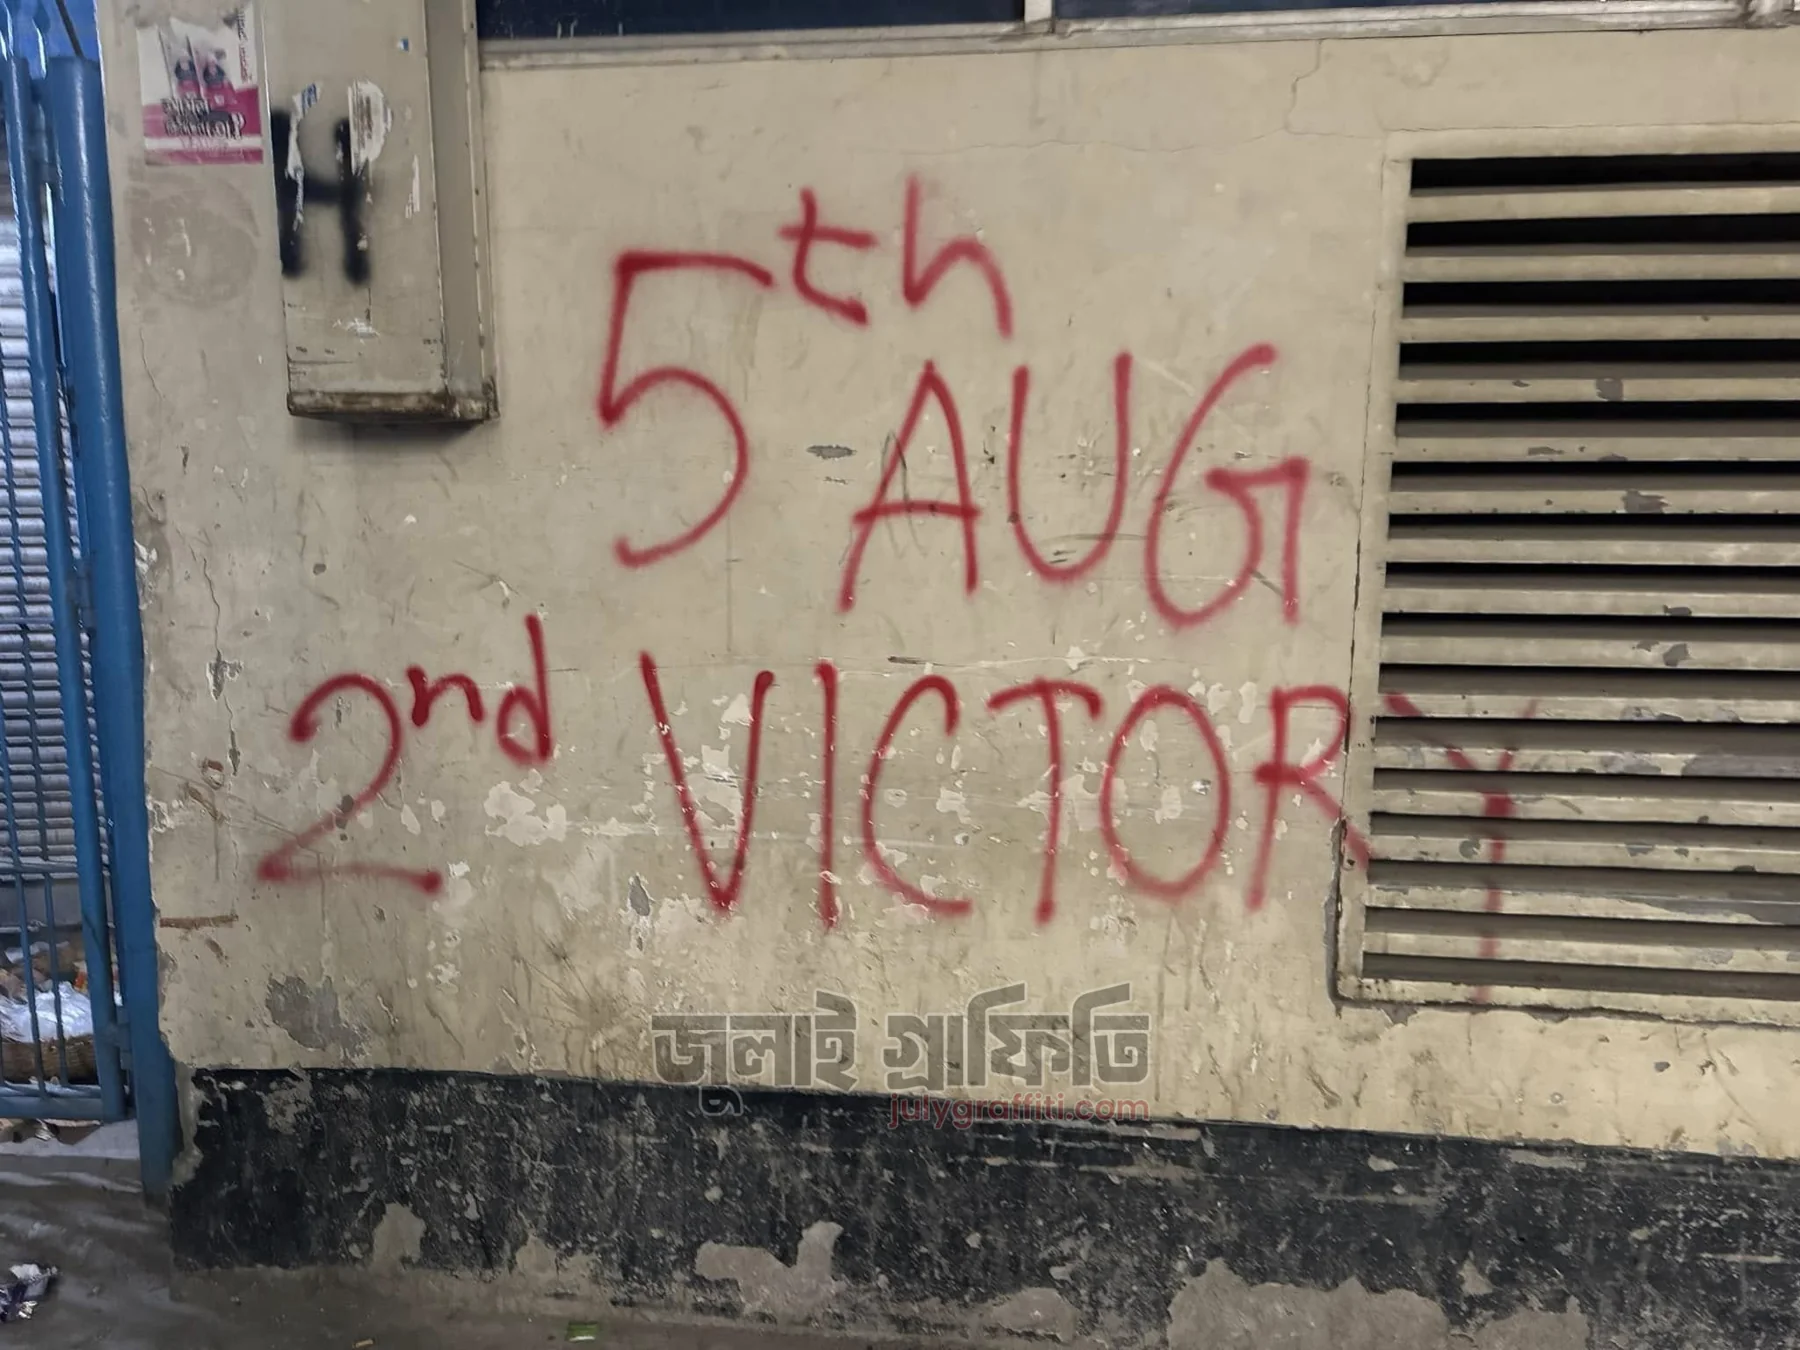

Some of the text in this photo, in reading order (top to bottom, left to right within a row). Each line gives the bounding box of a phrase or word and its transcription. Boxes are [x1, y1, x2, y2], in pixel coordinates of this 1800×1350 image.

[596, 175, 1308, 628] 5th AUG
[257, 614, 1537, 1003] 2nd VICTORY
